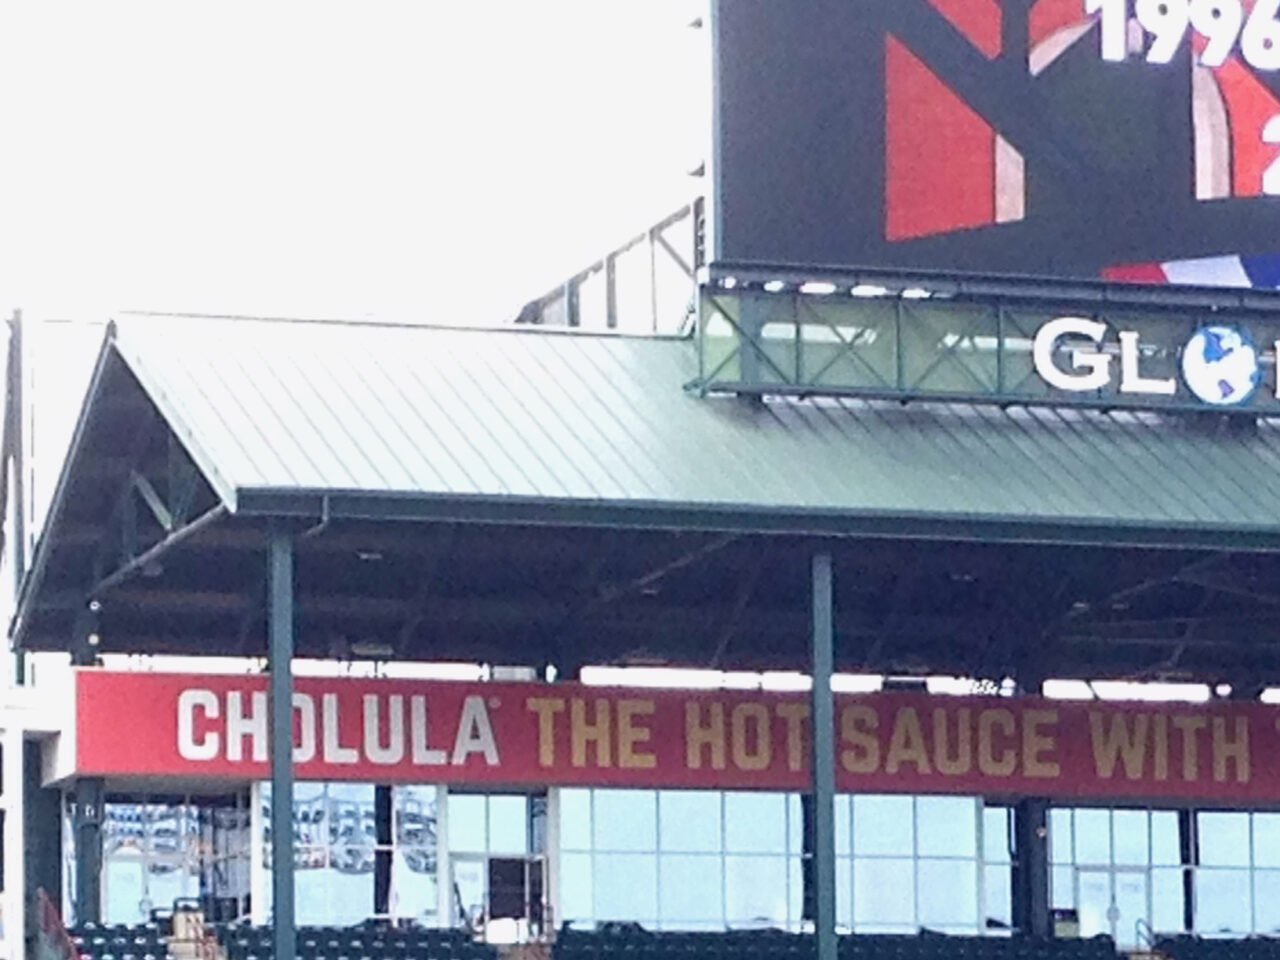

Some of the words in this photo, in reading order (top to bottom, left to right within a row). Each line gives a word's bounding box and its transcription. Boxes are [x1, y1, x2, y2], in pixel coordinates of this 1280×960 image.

[177, 688, 501, 767] CHOLULA
[526, 696, 657, 769] THE
[684, 700, 811, 772] HOT
[841, 706, 1062, 780] SAUCE
[1089, 710, 1252, 785] WITH
